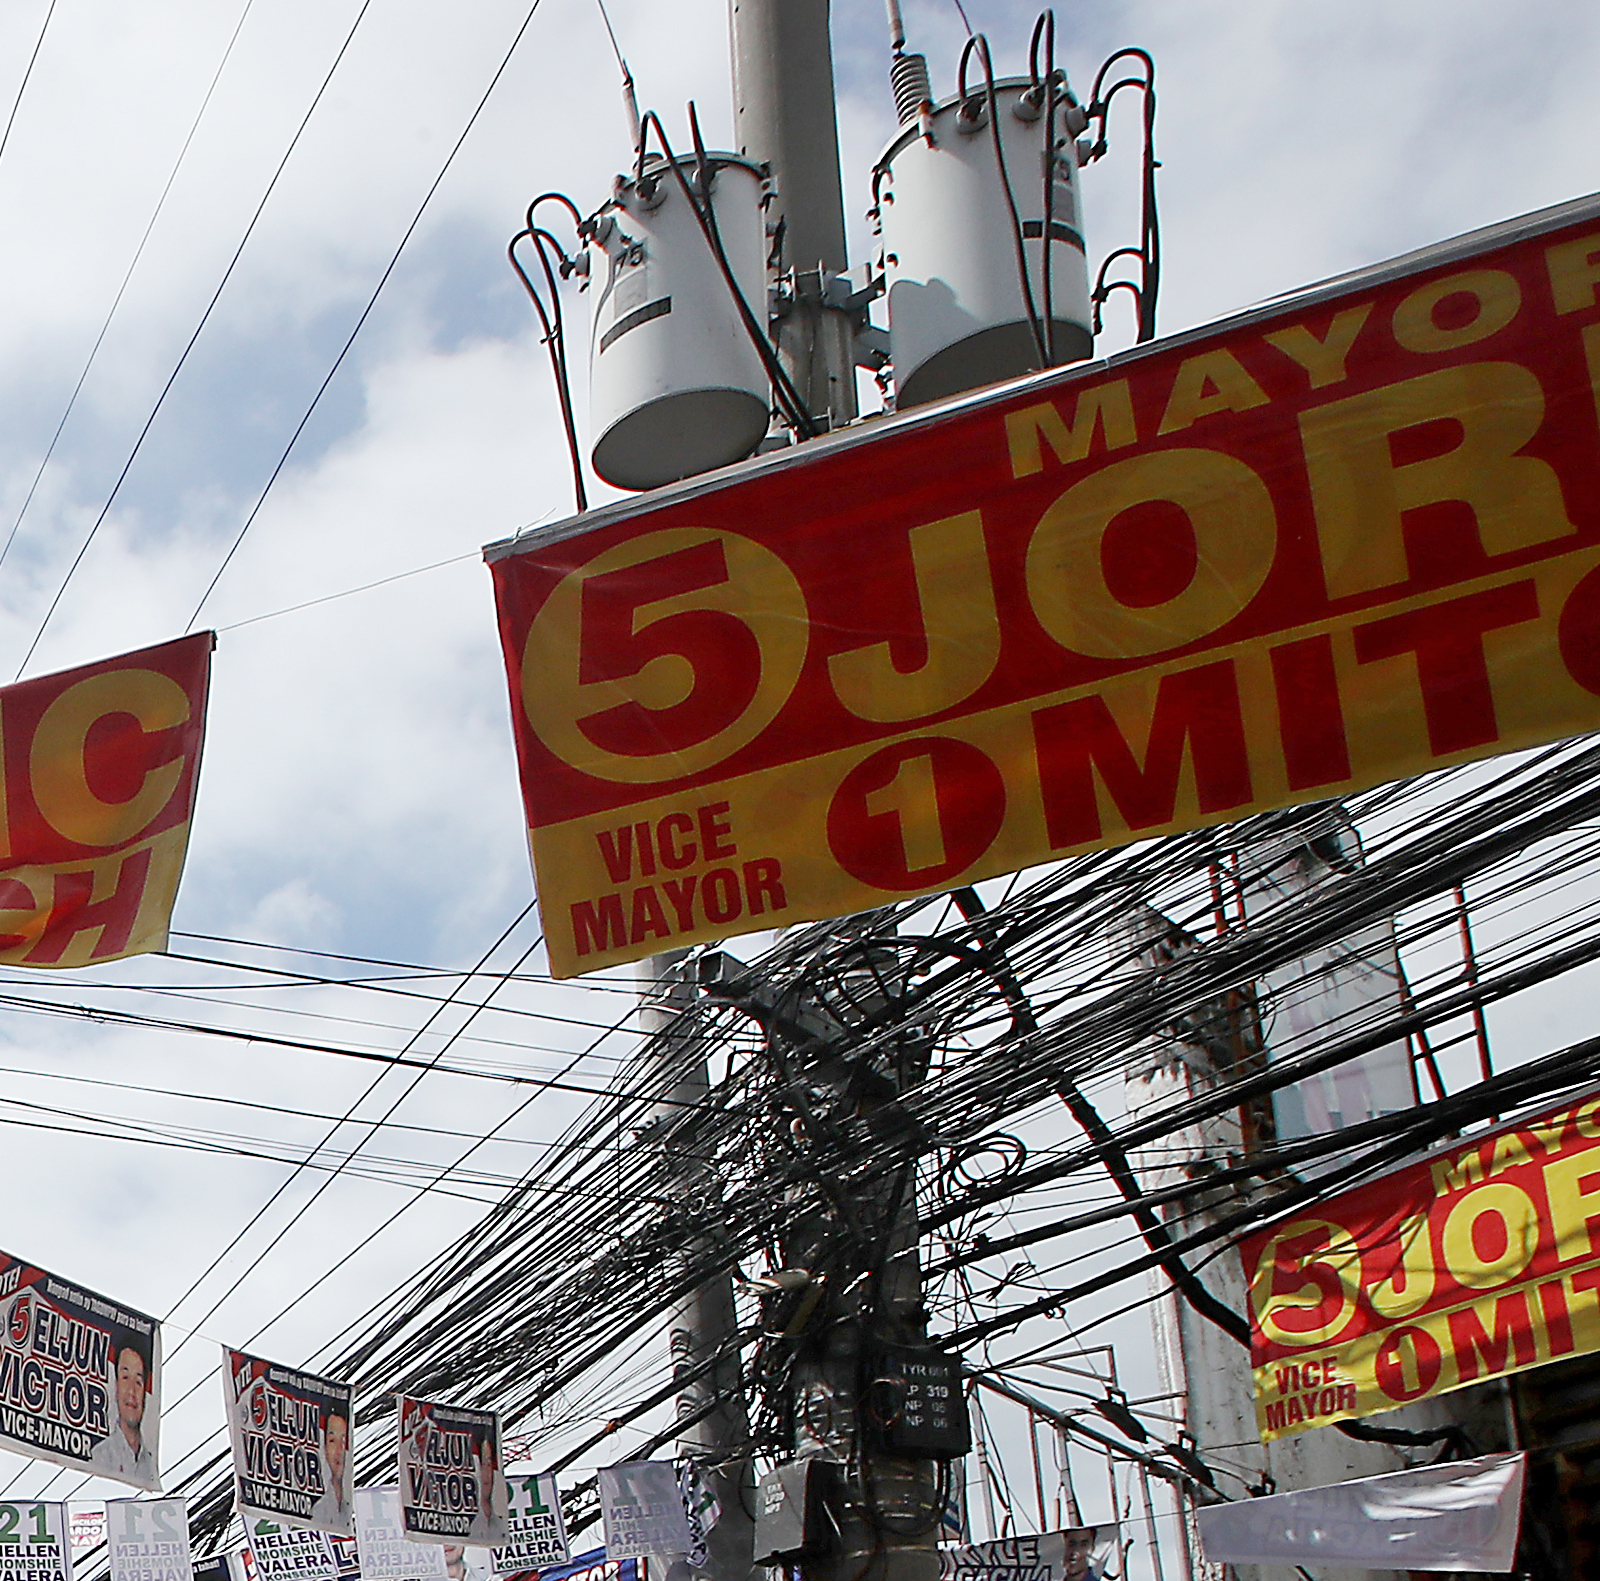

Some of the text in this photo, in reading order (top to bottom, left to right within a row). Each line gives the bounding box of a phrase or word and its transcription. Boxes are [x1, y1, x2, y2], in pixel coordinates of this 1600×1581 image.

[575, 536, 764, 761] 5
[569, 857, 788, 957] MAYOR
[864, 752, 951, 874] 1
[595, 801, 740, 886] VICE
[1267, 1225, 1346, 1335] 5
[31, 1304, 112, 1379] ELJUN
[1265, 1383, 1357, 1432] MAYOR
[1388, 1333, 1421, 1392] 1
[1, 1409, 93, 1459] VICE-MAYOR
